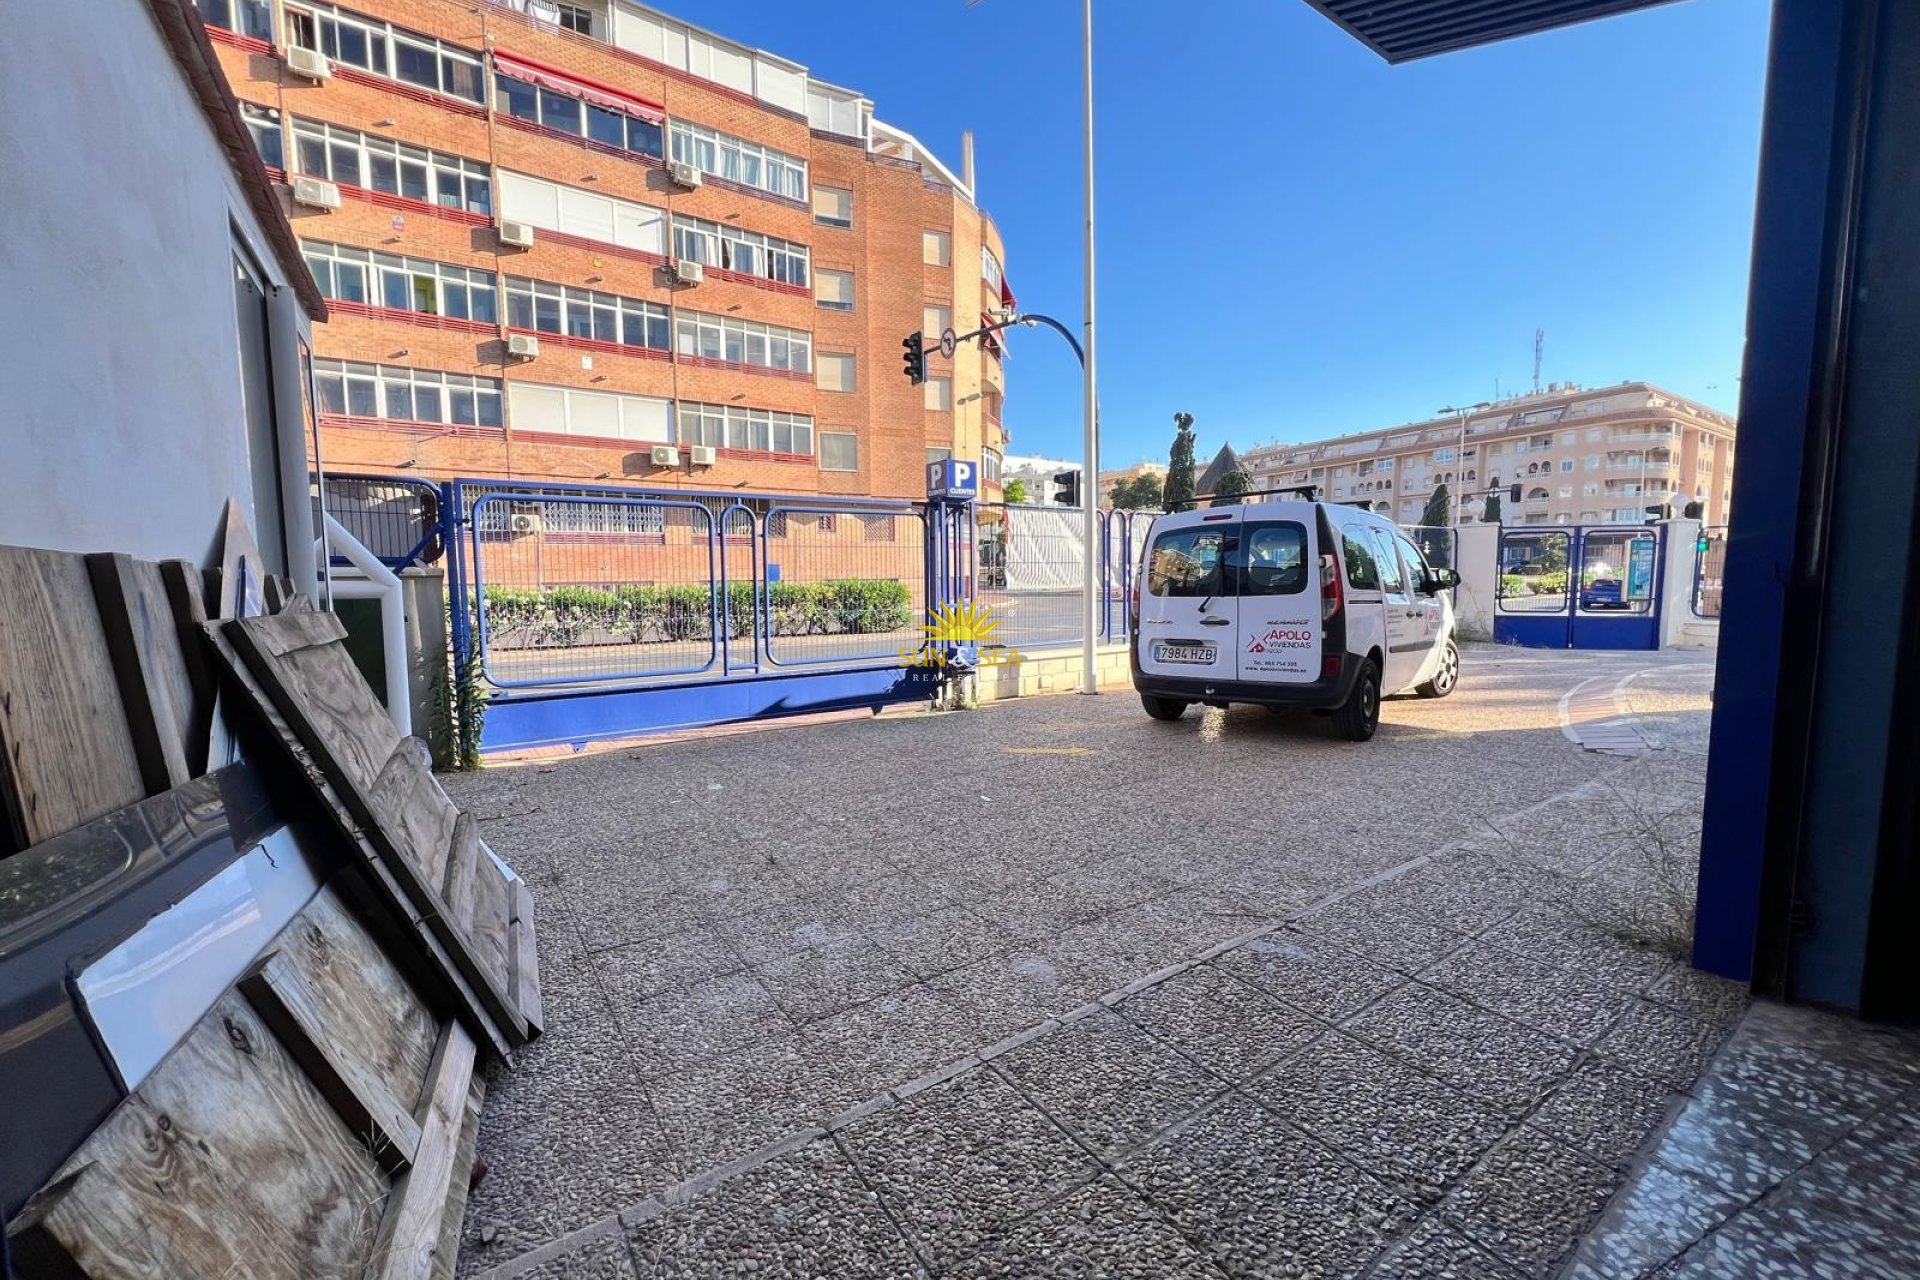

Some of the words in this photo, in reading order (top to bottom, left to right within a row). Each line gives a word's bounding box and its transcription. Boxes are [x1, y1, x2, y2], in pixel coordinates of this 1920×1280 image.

[931, 465, 942, 489] P
[954, 462, 970, 487] P
[1269, 630, 1311, 641] APOLO
[1162, 648, 1187, 659] 7984
[1191, 650, 1214, 661] HZB
